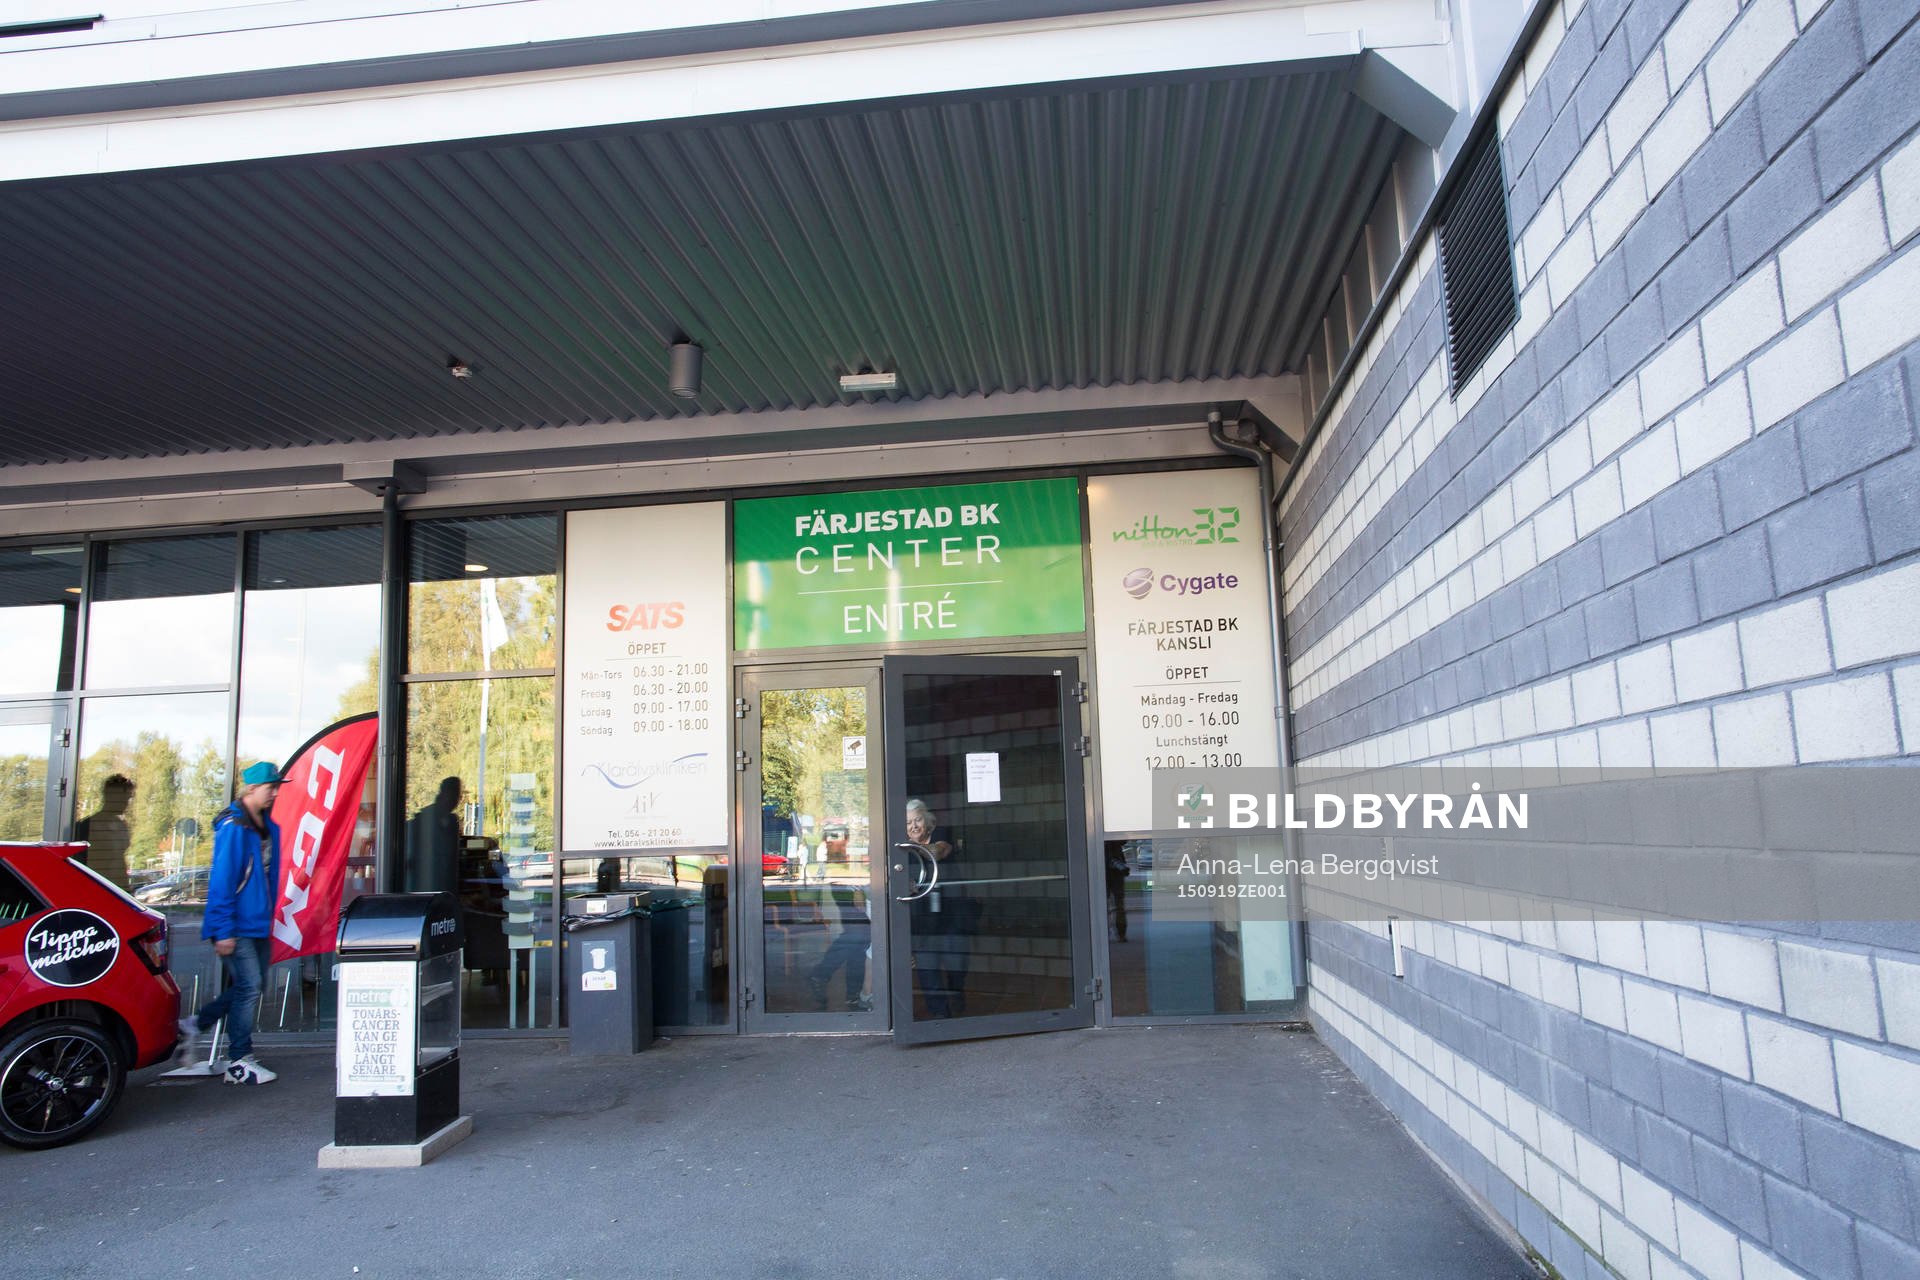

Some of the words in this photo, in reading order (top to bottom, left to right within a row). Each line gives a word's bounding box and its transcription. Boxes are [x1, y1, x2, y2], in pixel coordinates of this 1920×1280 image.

[796, 507, 953, 536] FÄRJESTAD
[960, 504, 1001, 526] BK
[795, 535, 1001, 575] CENTER
[1160, 573, 1239, 595] Cygate
[606, 602, 685, 632] SATS
[844, 592, 957, 633] ENTRÉ
[1128, 619, 1213, 636] FÄRJESTAD
[1218, 618, 1239, 631] BK
[627, 642, 667, 656] ÖPPET
[1156, 636, 1212, 651] KANSLI
[633, 665, 665, 678] 06.30
[677, 663, 708, 676] 21.00
[1166, 667, 1209, 680] ÖPPET
[581, 689, 611, 700] Fredag
[633, 683, 665, 696] 06.30
[677, 681, 708, 694] 20.00
[633, 702, 665, 714] 09.00
[677, 700, 708, 712] 17.00
[1141, 694, 1186, 707] Måndag
[1197, 692, 1238, 705] Fredag
[633, 720, 665, 733] 09.00
[677, 718, 708, 731] 18.00
[1142, 713, 1182, 729] 09.00
[1199, 711, 1240, 726] 16.00
[1156, 735, 1228, 748] Lunchstängt
[1145, 755, 1185, 771] 12.00
[1201, 753, 1242, 769] 13.00
[608, 830, 622, 839] Tel.
[625, 830, 640, 838] 054
[648, 829, 657, 837] 21
[660, 829, 670, 837] 20
[272, 744, 346, 952] CCM
[431, 918, 456, 936] metro
[31, 926, 98, 949] Tippa
[31, 937, 119, 969] matchen
[352, 1008, 400, 1019] TONÅRS-
[352, 1020, 400, 1030] CANCER
[354, 1031, 379, 1041] KAN
[382, 1031, 398, 1041] GE
[354, 1043, 396, 1053] ÅNGEST
[355, 1053, 395, 1064] LÅNGT
[352, 1065, 396, 1075] SENARE
